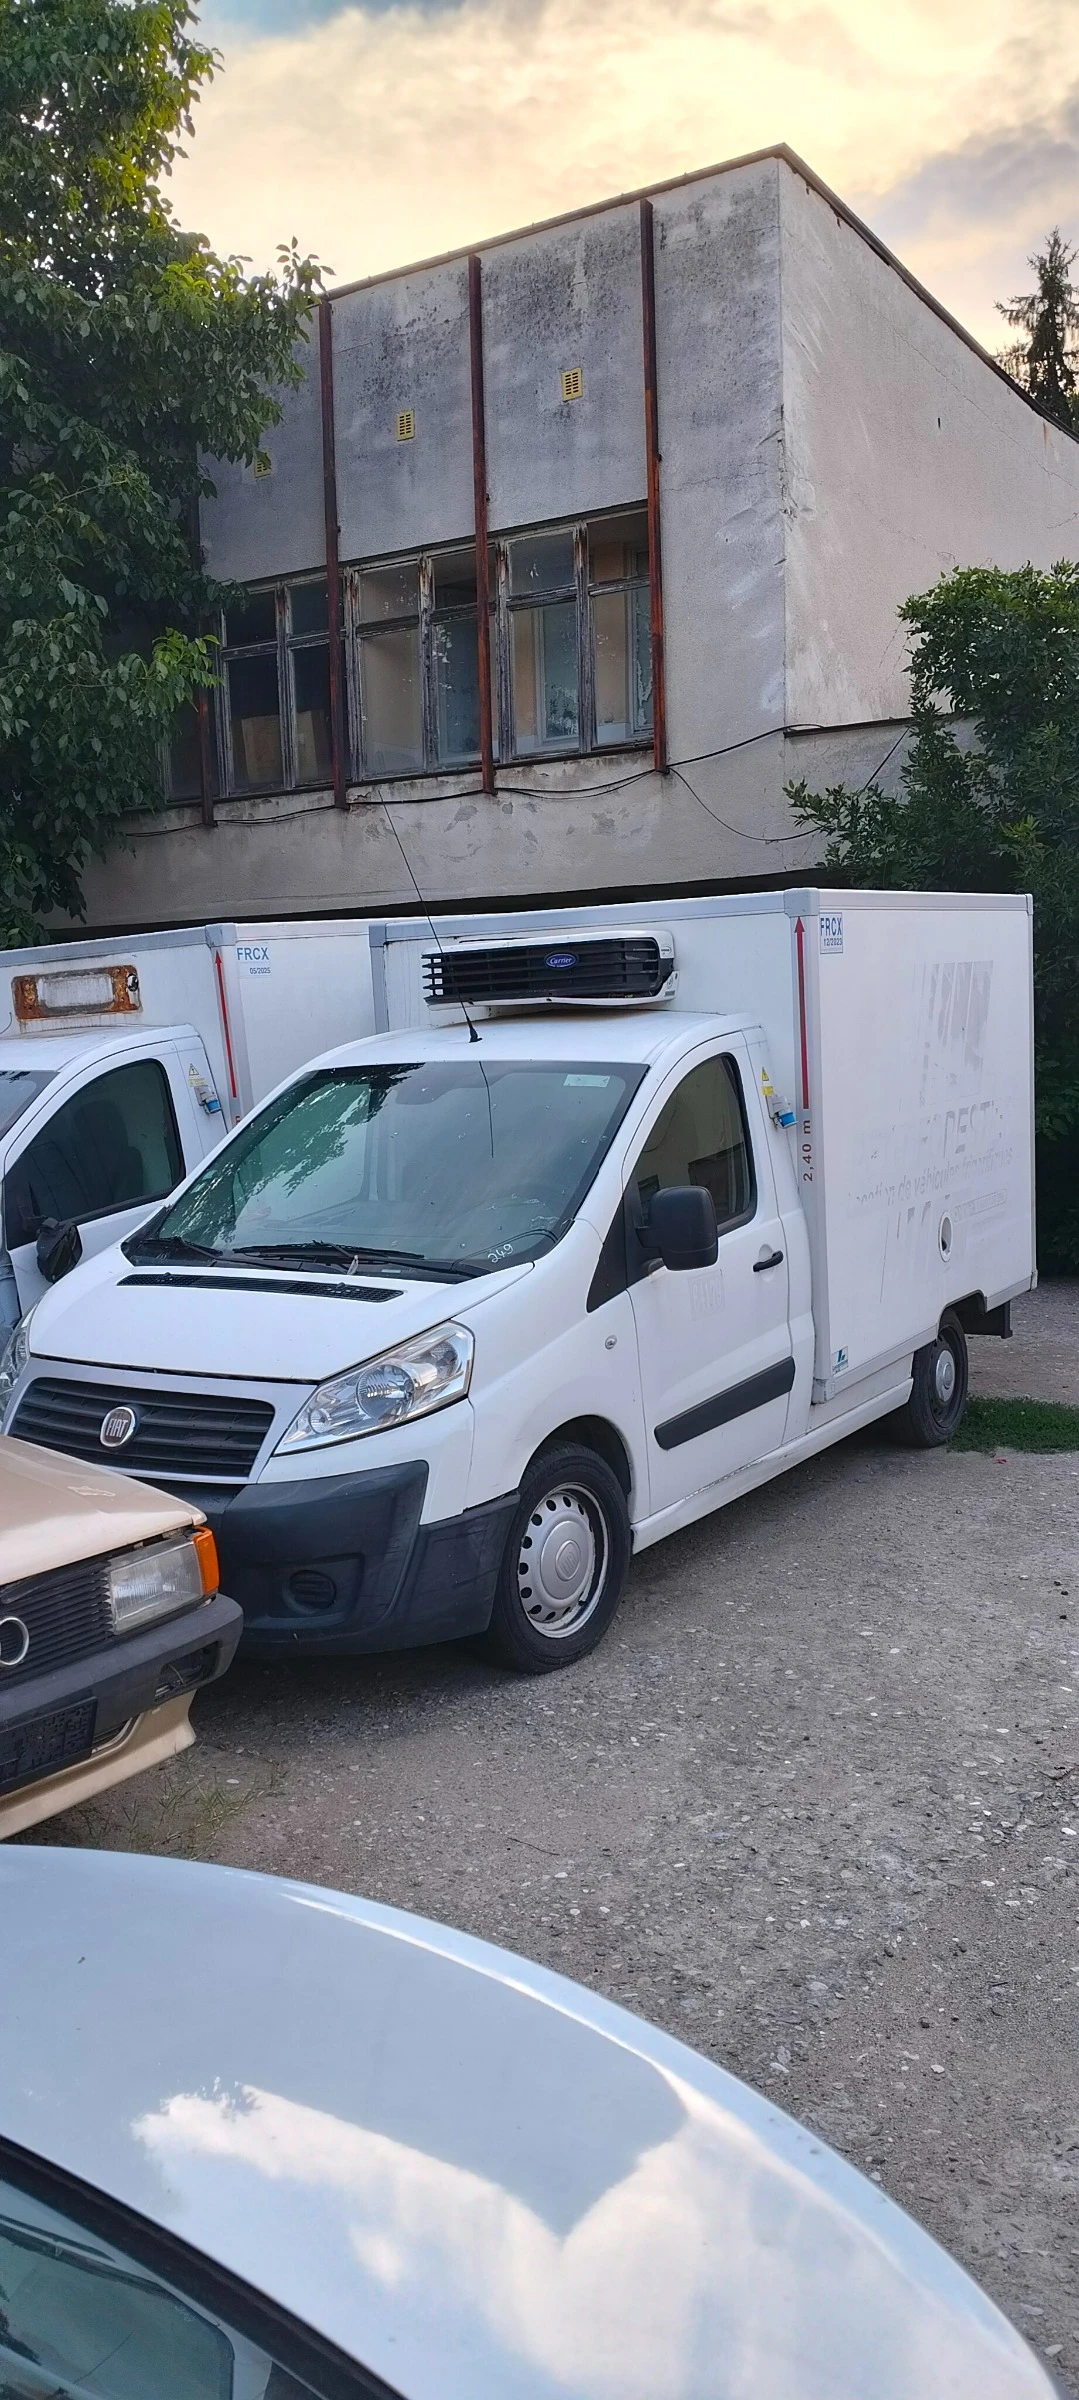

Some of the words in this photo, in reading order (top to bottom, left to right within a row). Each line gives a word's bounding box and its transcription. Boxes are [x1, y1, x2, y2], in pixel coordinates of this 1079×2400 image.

[820, 917, 842, 936] FRCX
[236, 947, 270, 961] FRCX
[549, 956, 572, 965] Carrier
[249, 966, 271, 975] 05/2025
[803, 1119, 811, 1135] m
[801, 1143, 814, 1182] 2,40
[487, 1243, 514, 1263] 249
[105, 1417, 129, 1438] FIAT
